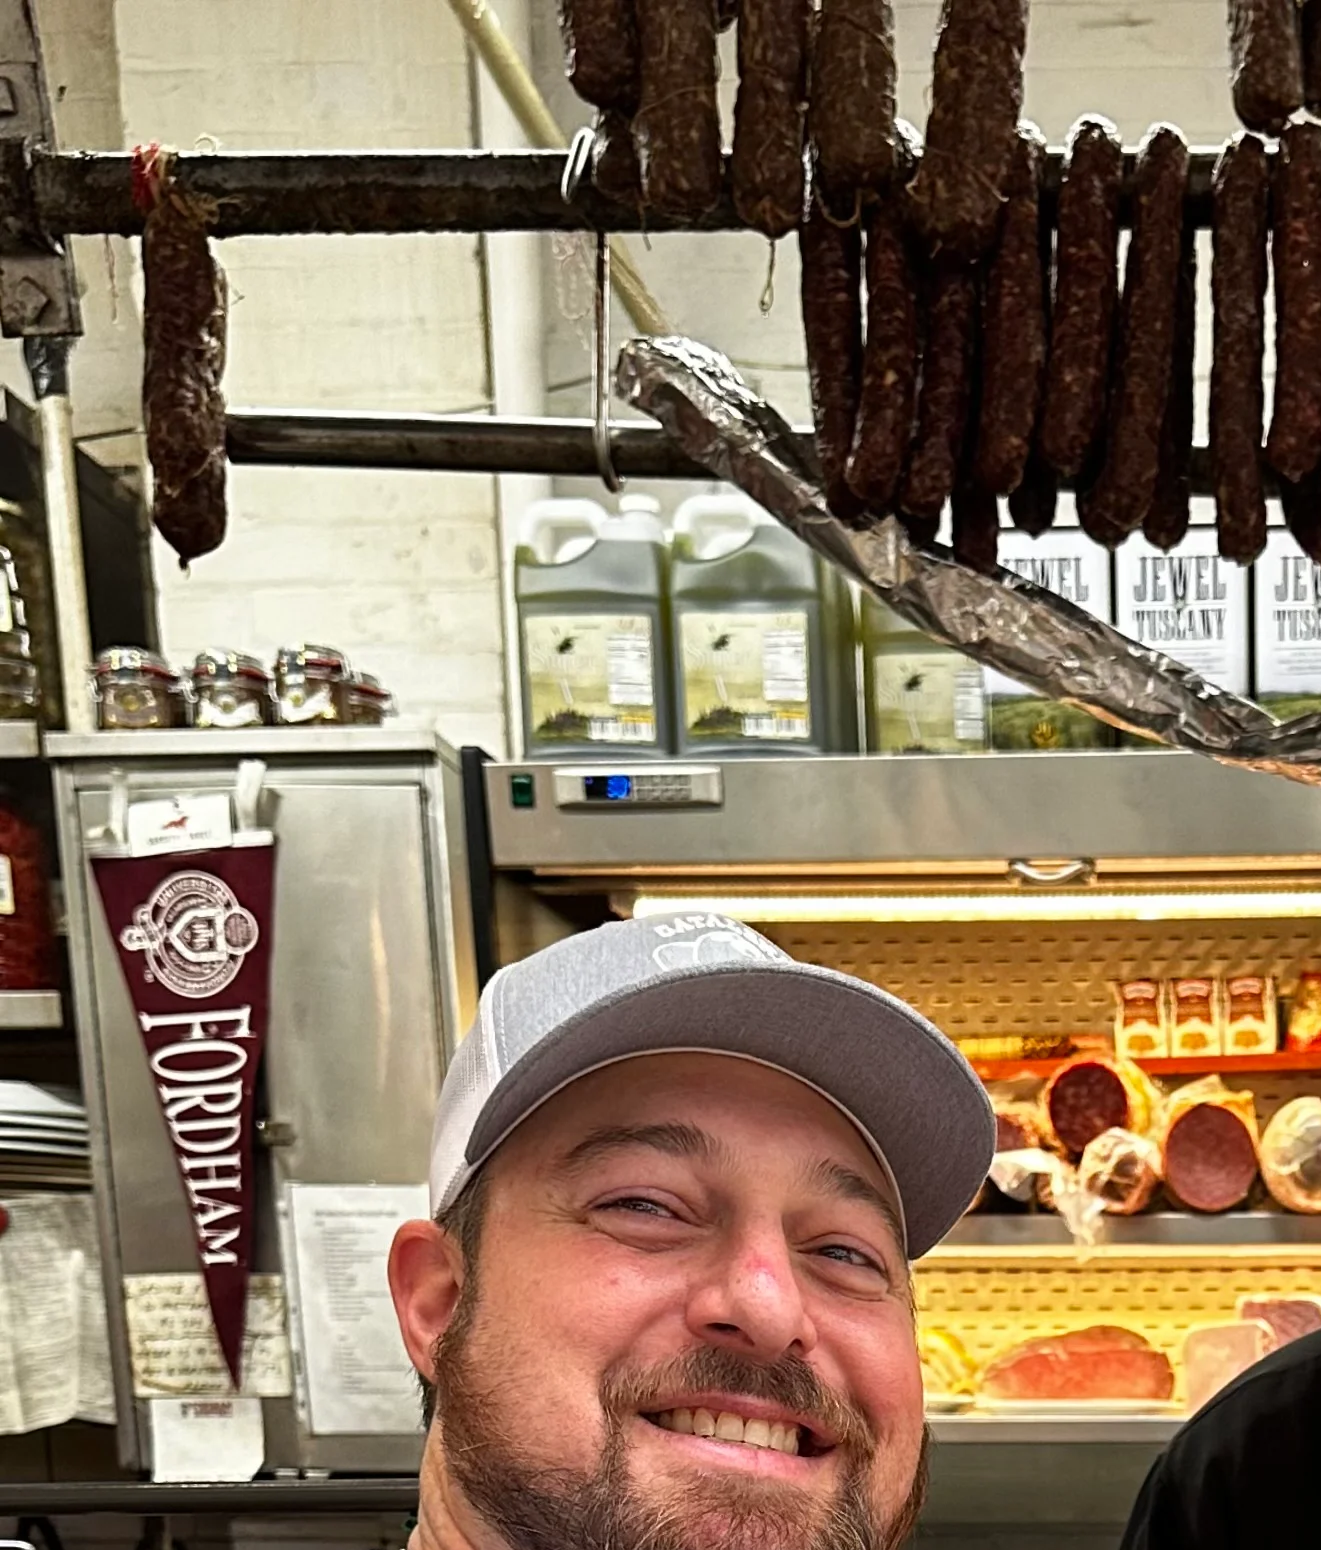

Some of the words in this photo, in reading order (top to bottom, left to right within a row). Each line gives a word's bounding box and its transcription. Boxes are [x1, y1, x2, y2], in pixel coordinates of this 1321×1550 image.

[1133, 556, 1227, 601] JEWEL
[1132, 609, 1227, 641] TUSCANY
[140, 1003, 256, 1266] FORDHAM
